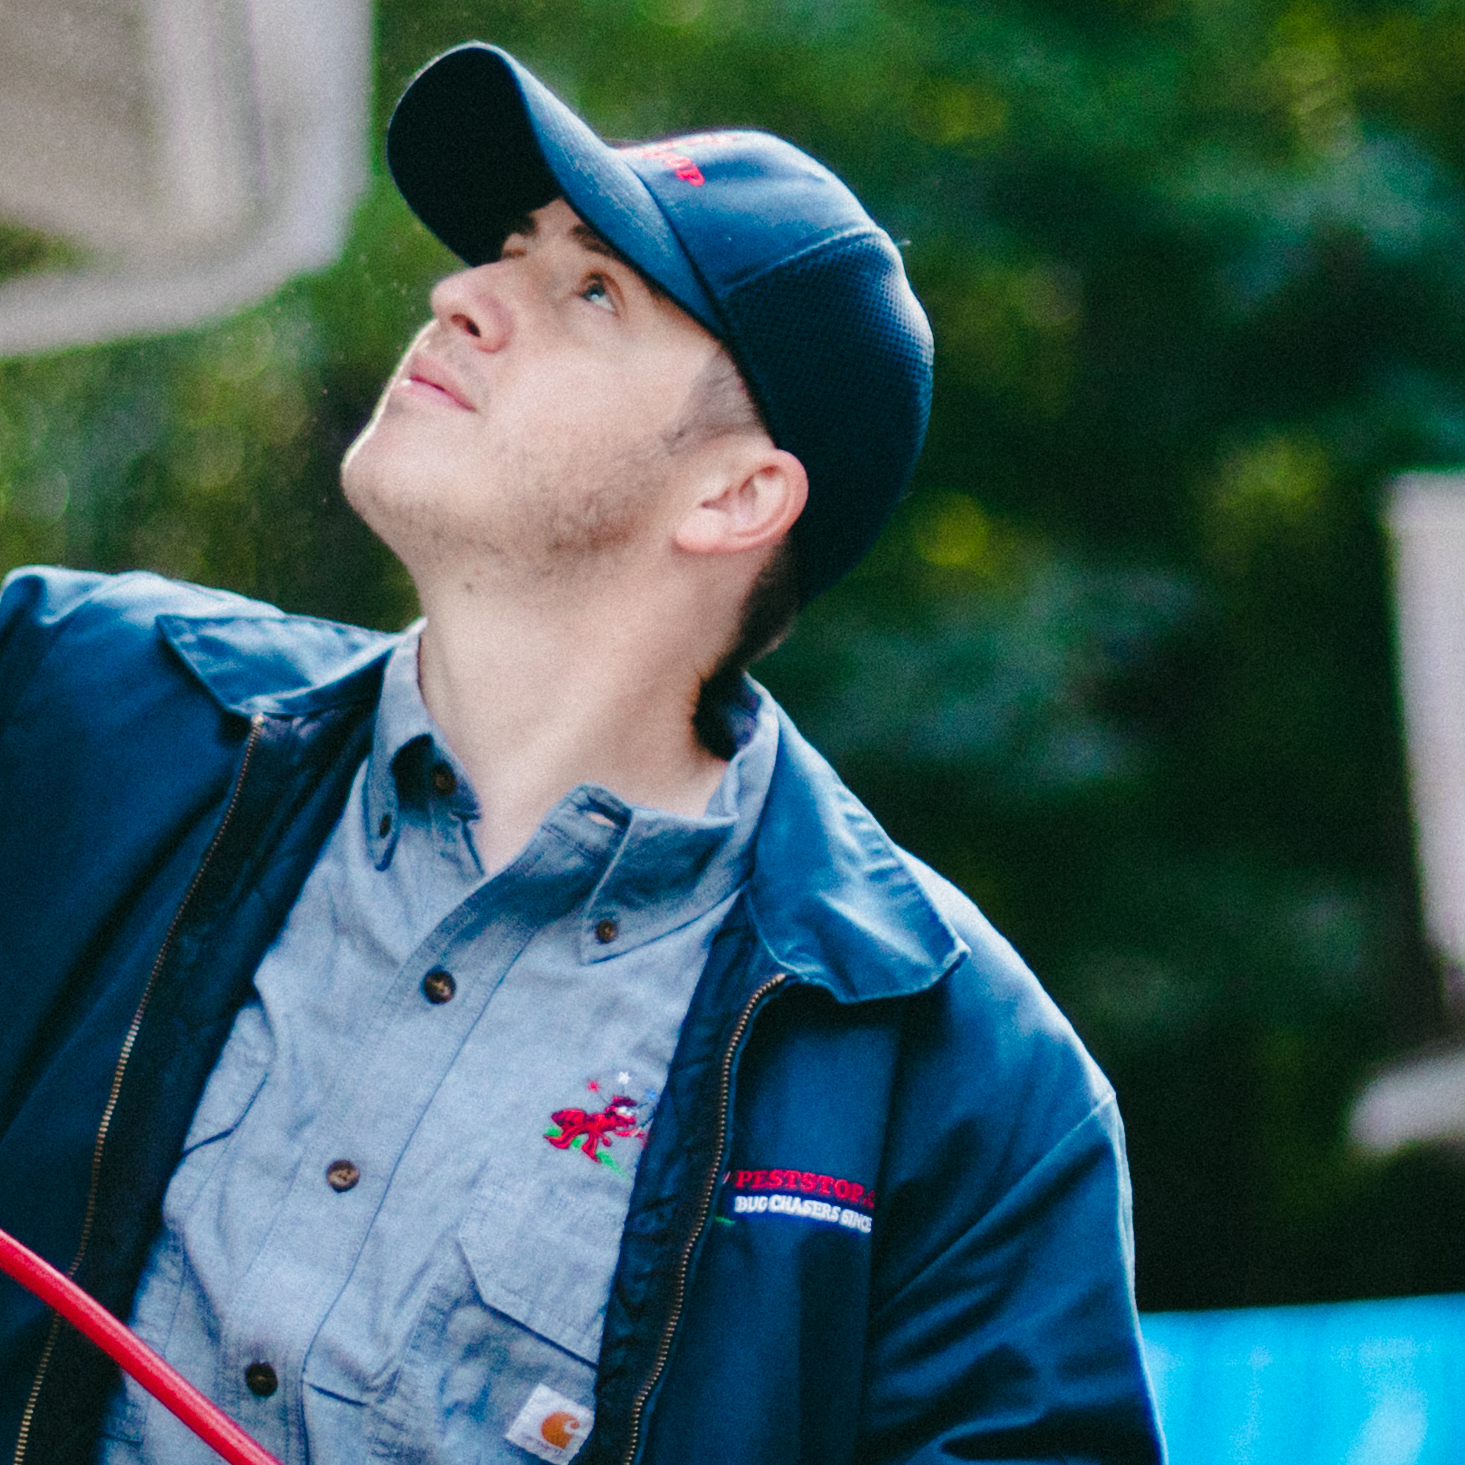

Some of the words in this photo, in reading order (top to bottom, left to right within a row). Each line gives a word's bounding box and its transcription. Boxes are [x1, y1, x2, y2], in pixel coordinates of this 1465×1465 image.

[734, 1195, 768, 1214] BUG
[768, 1194, 841, 1223] CHASERS
[839, 1208, 873, 1234] SINCE
